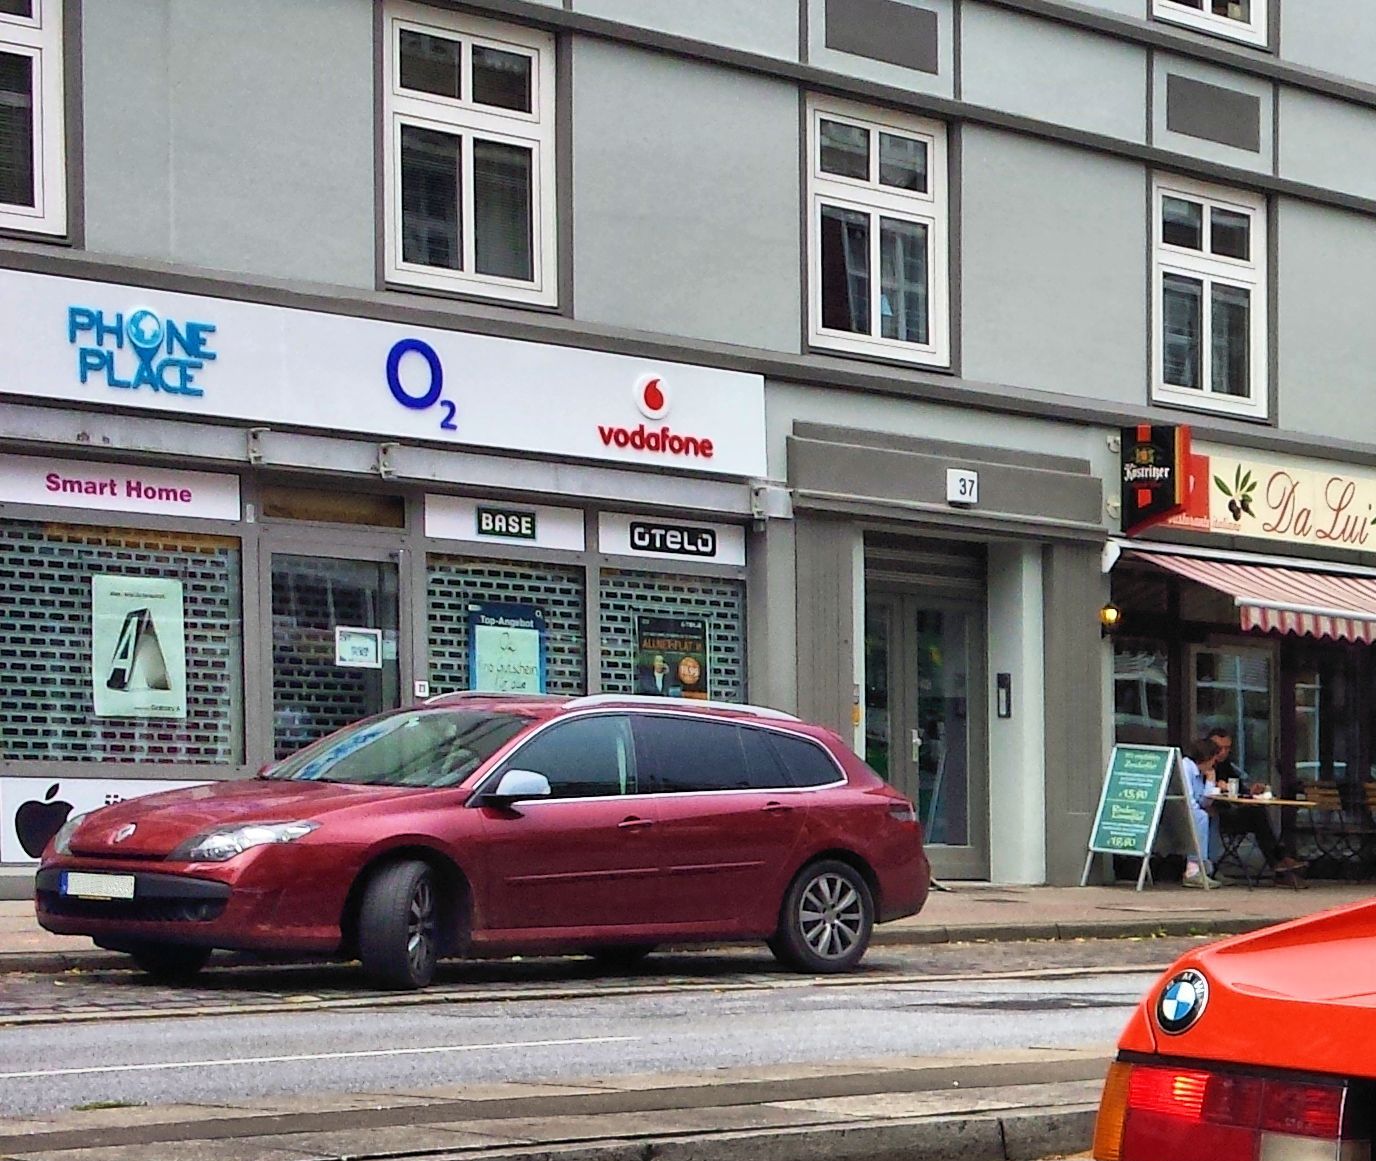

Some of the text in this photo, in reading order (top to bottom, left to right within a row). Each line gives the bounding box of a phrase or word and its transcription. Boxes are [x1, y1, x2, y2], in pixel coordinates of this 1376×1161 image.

[68, 306, 217, 360] PHONE
[79, 347, 204, 397] PLACE
[598, 423, 714, 459] vodafone
[46, 473, 193, 503] Smart Home
[958, 477, 976, 497] 37
[481, 513, 533, 536] BASE
[1262, 471, 1372, 546] Da Lui
[480, 614, 535, 629] Top-Angebot
